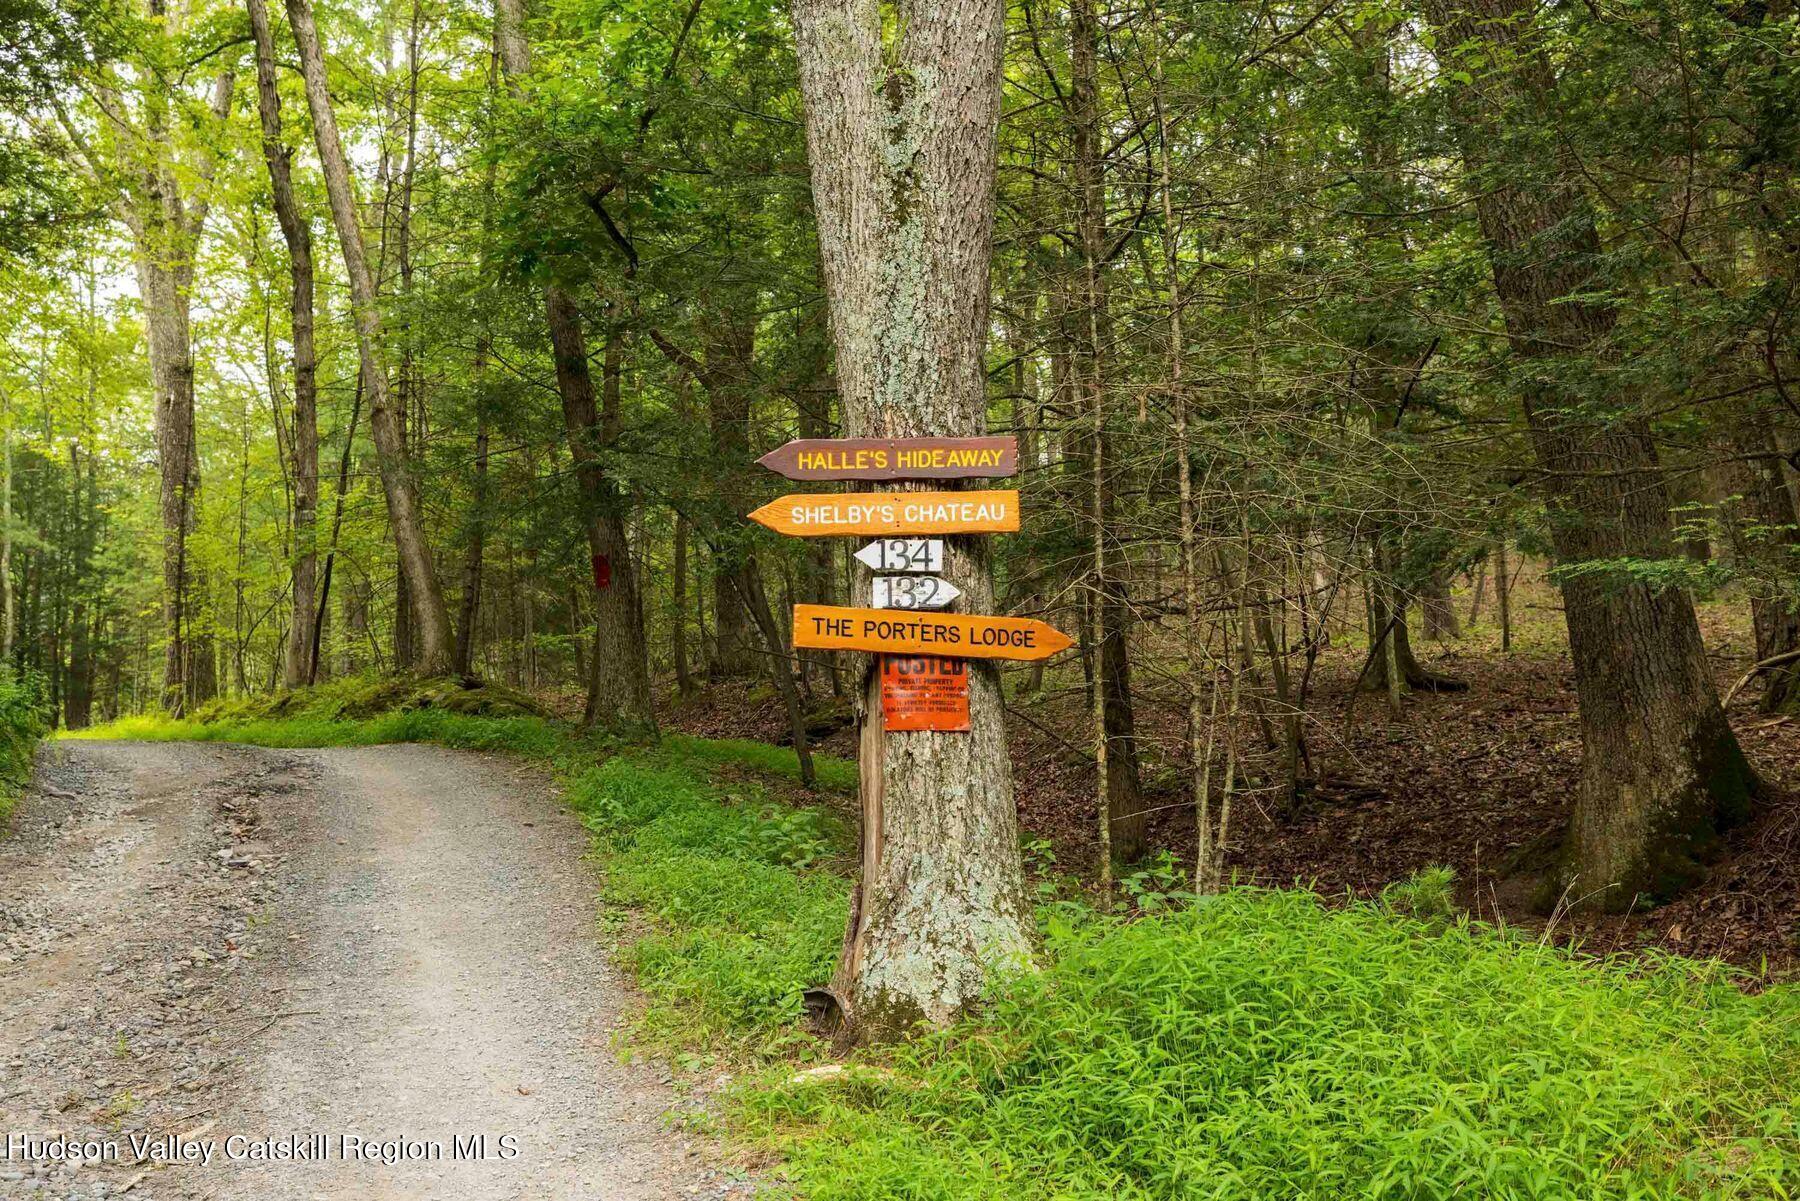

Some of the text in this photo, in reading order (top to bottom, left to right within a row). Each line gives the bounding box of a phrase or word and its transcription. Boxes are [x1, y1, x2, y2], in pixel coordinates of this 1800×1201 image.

[798, 449, 1004, 470] HALLE'S HIDEAWAY
[791, 503, 1006, 525] SHELBY'S CHATEAU
[876, 539, 934, 571] 134
[882, 576, 940, 610] 132
[811, 617, 1036, 648] THE PORTERS LODGE
[884, 656, 963, 675] POSTED
